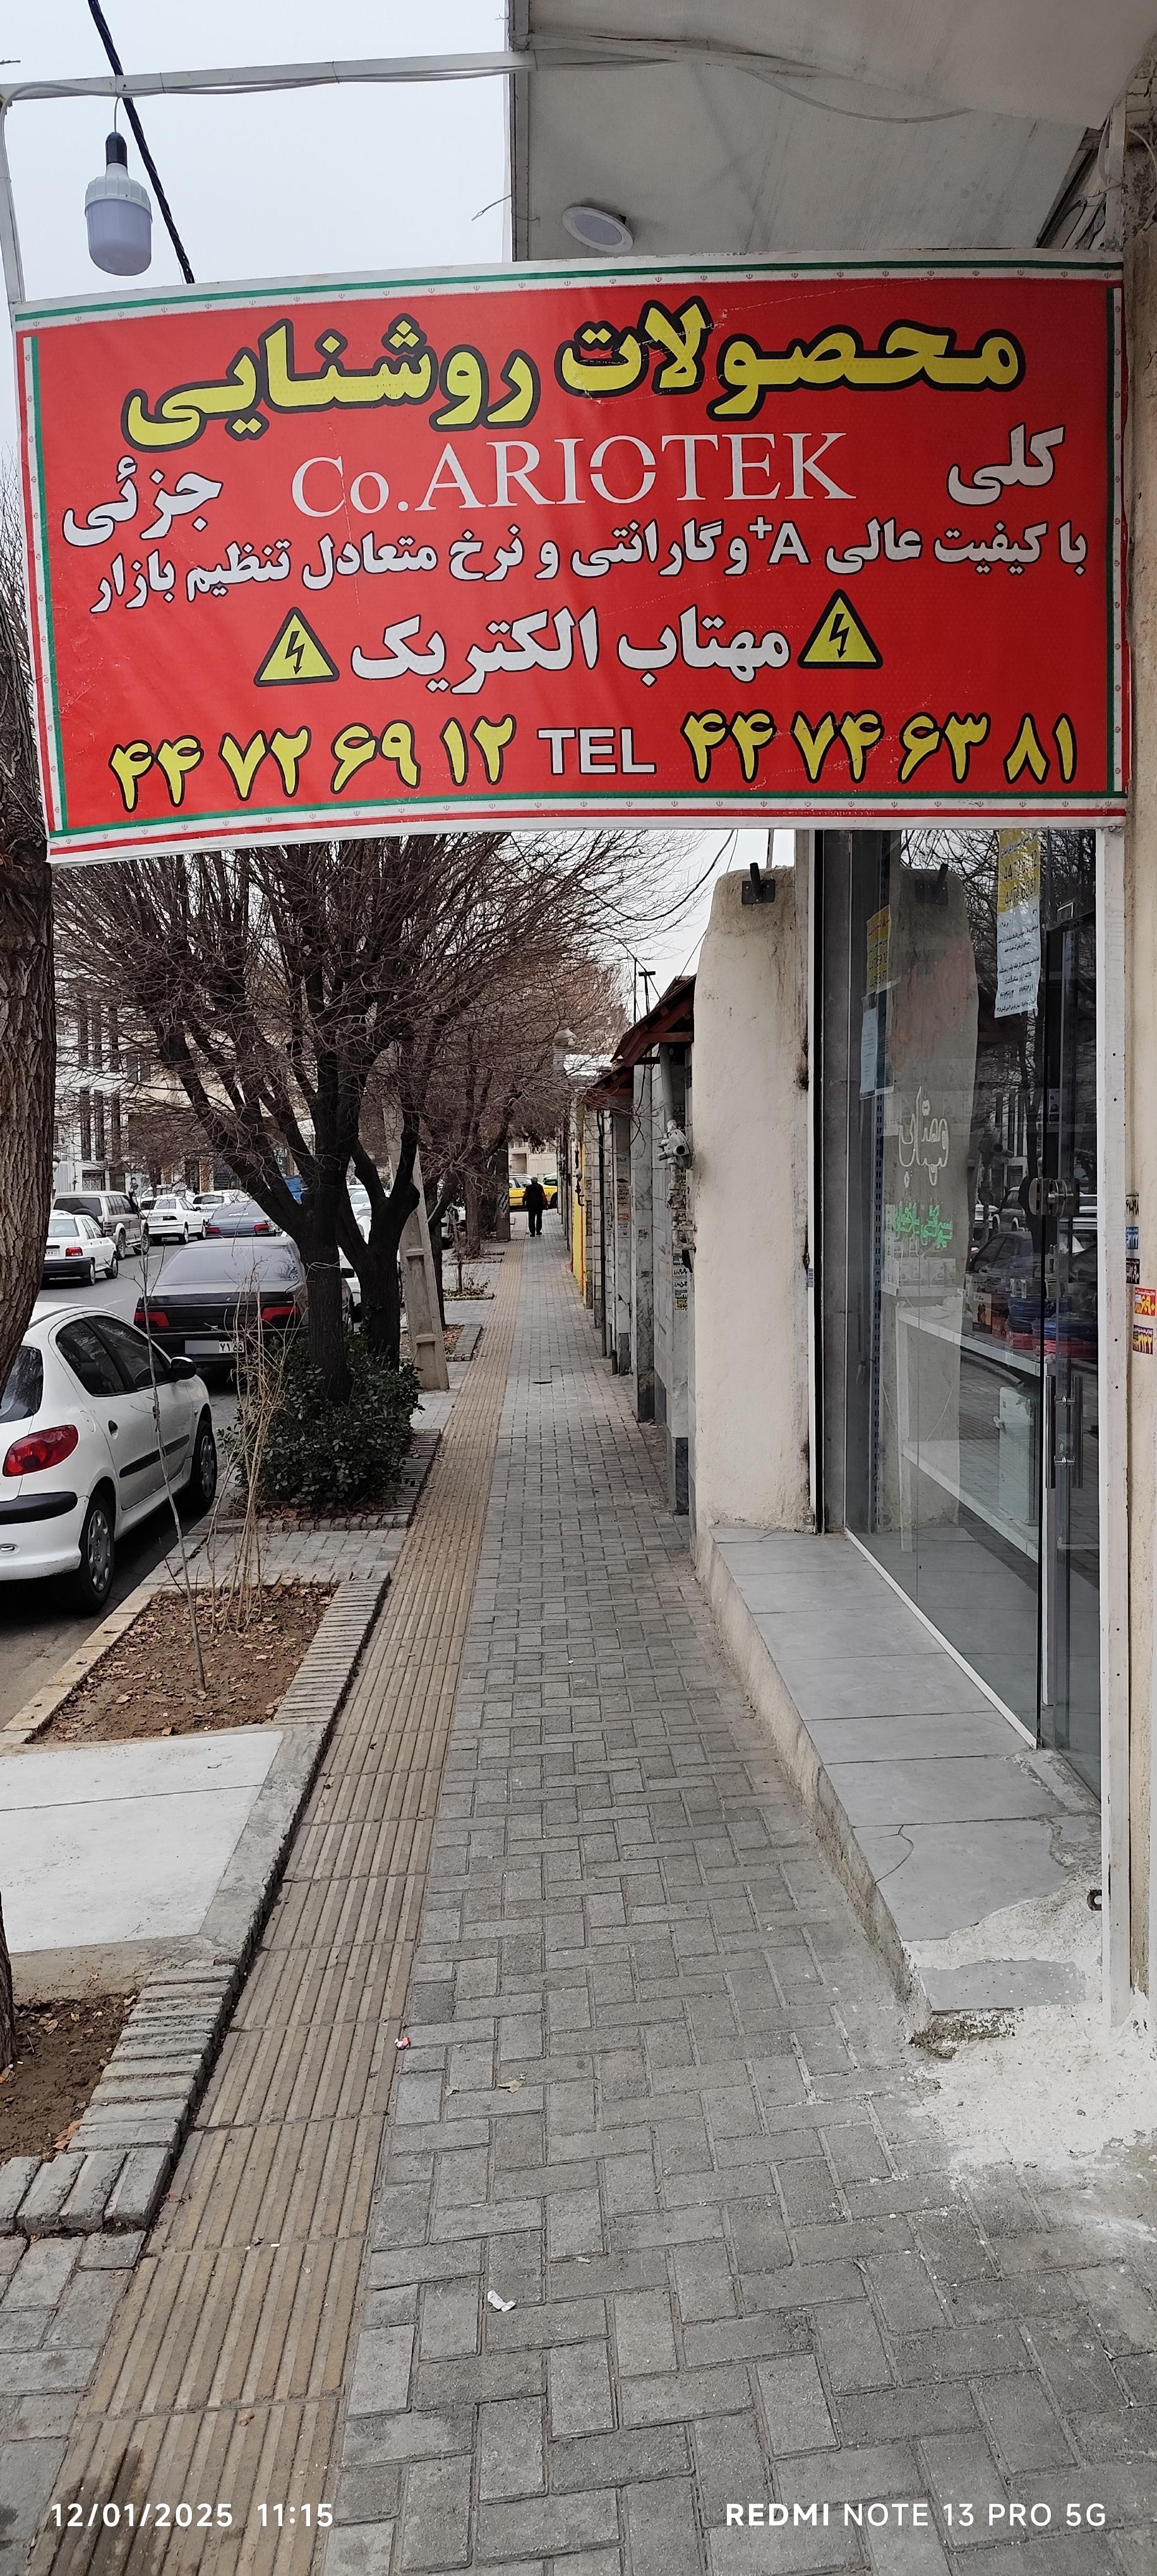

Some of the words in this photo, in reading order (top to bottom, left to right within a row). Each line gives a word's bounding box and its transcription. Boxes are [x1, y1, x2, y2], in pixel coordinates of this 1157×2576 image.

[122, 314, 541, 451] روشنایی
[556, 297, 1025, 420] محصولات
[62, 455, 223, 547] جزئی
[291, 432, 856, 518] Co.ARIOTEK
[947, 423, 1065, 506] کلی
[89, 550, 176, 614] بازار
[186, 539, 292, 603] تنظیم
[301, 532, 438, 590] متعادل
[449, 525, 524, 581] نرخ
[535, 540, 559, 580] و
[825, 517, 923, 575] عالی
[934, 520, 1048, 574] کیفیت
[1058, 520, 1088, 575] با
[351, 606, 599, 695] الکتریک
[617, 604, 791, 687] مهتاب
[109, 734, 202, 812] ۴۴
[219, 727, 311, 799] ۷۲
[331, 721, 421, 794] ۶۹
[440, 714, 517, 786] ۱۲
[537, 727, 656, 775] TEL
[681, 709, 774, 784] ۴۴
[793, 710, 884, 784] ۷۴
[898, 712, 990, 784] ۶۳
[1004, 713, 1077, 784] ۸۱
